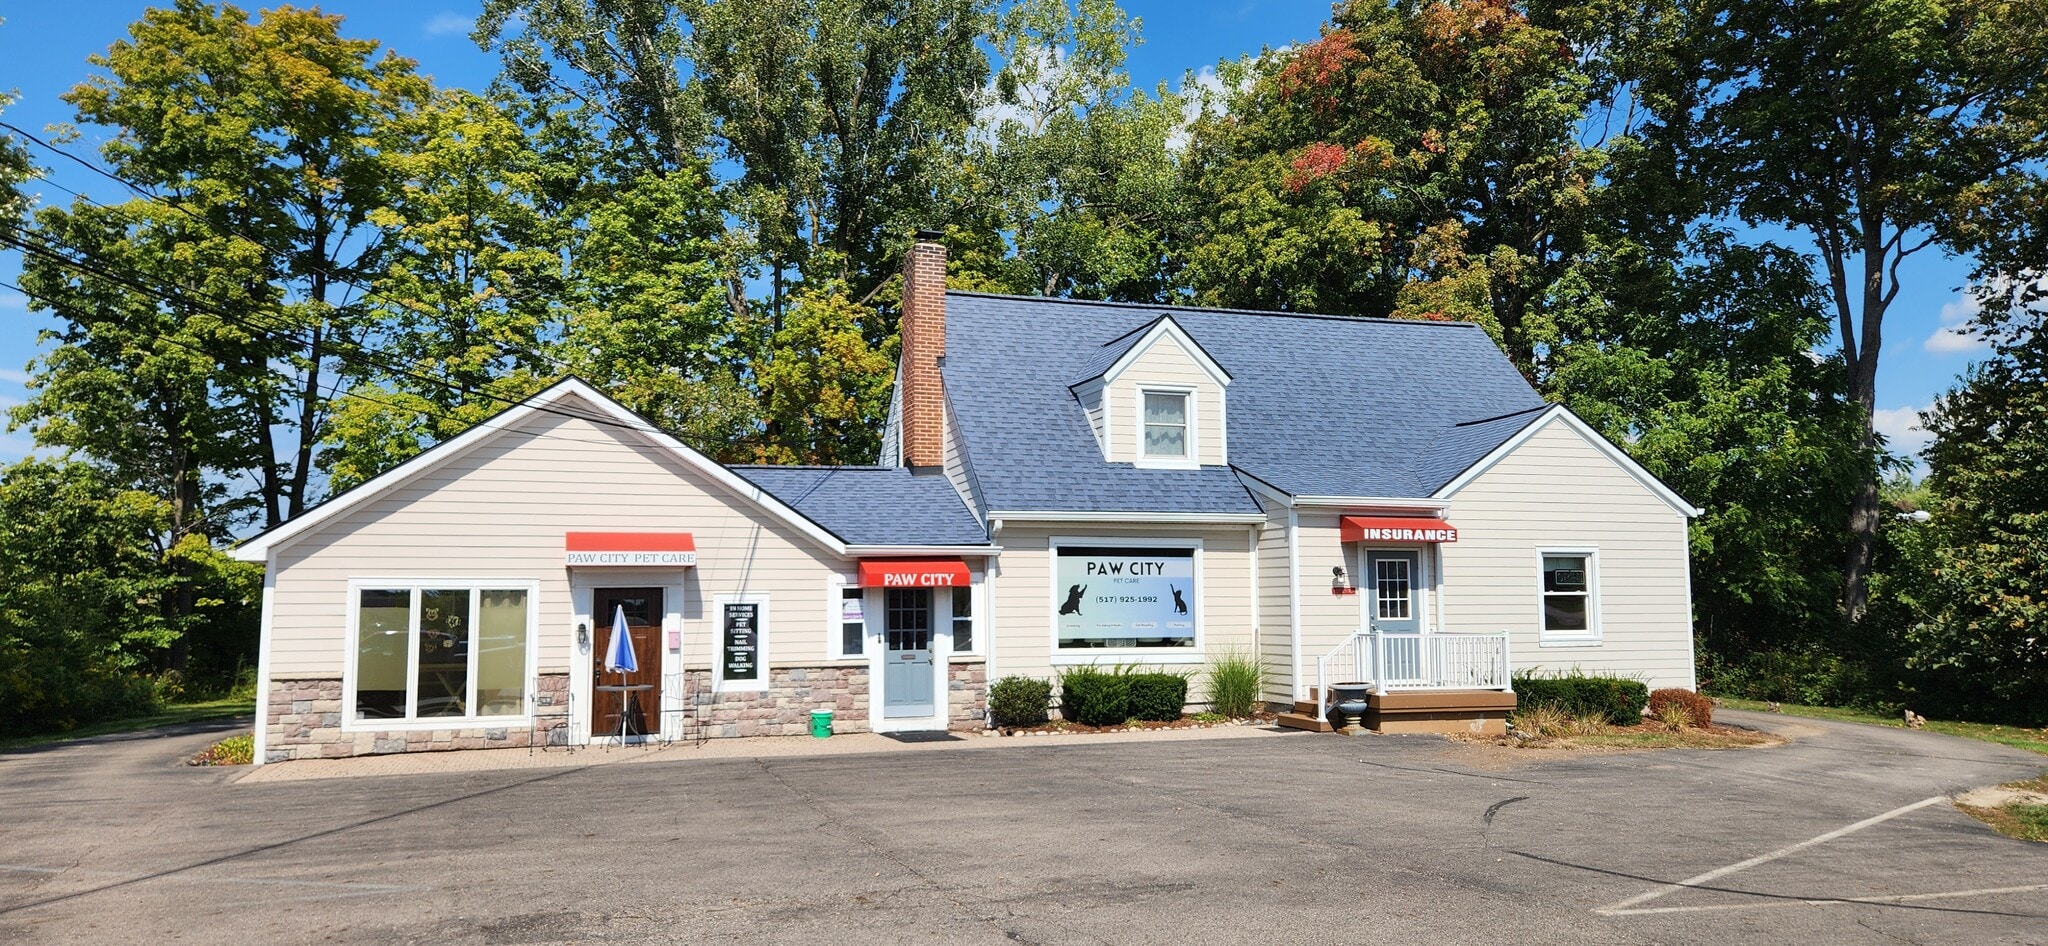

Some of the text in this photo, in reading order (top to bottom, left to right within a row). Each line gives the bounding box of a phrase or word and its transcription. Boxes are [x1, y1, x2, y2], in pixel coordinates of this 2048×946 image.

[1364, 528, 1456, 540] INSURANCE
[568, 553, 695, 563] PAW CITY PET CARE
[1087, 561, 1165, 576] PAW CITY
[884, 573, 955, 586] PAW CITY
[1095, 595, 1117, 604] (517)
